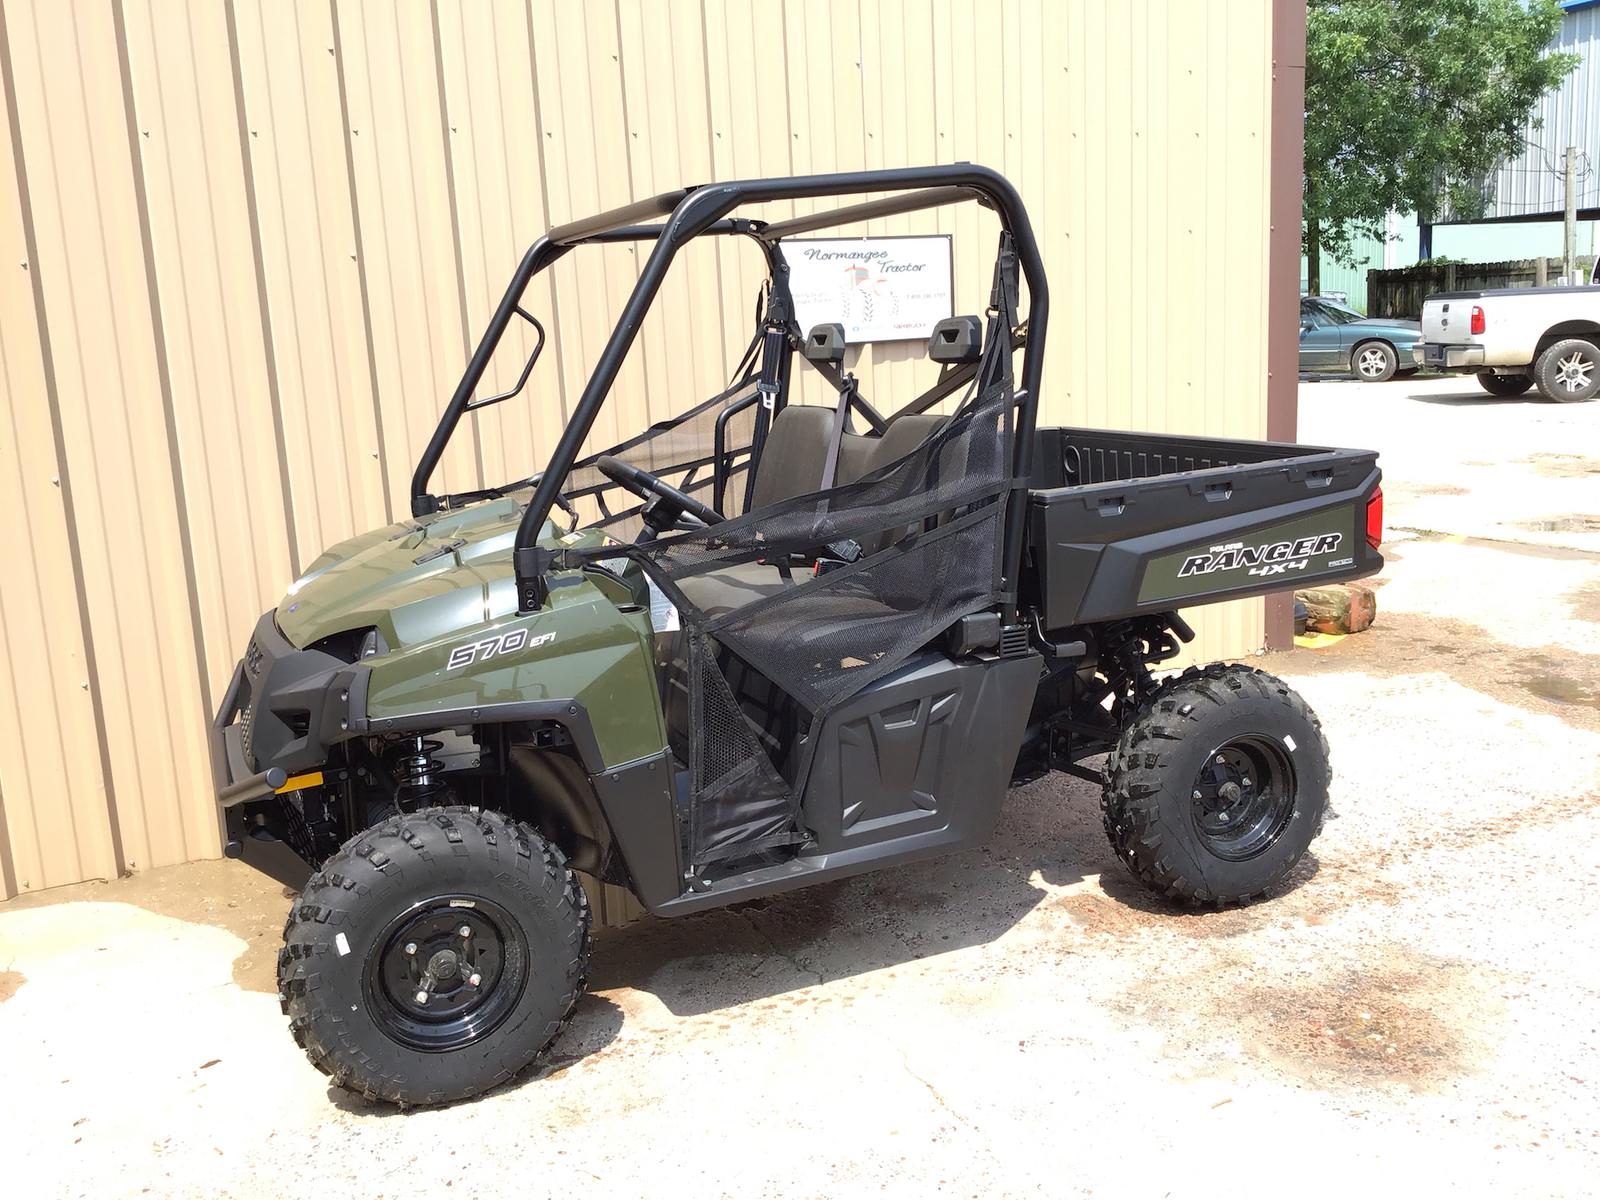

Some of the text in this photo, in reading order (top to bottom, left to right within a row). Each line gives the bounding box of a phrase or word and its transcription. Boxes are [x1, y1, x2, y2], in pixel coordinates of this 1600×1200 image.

[804, 248, 888, 263] Normangee
[877, 260, 926, 273] Tractor
[1177, 533, 1342, 577] RANGER
[447, 628, 556, 671] 570 EFI
